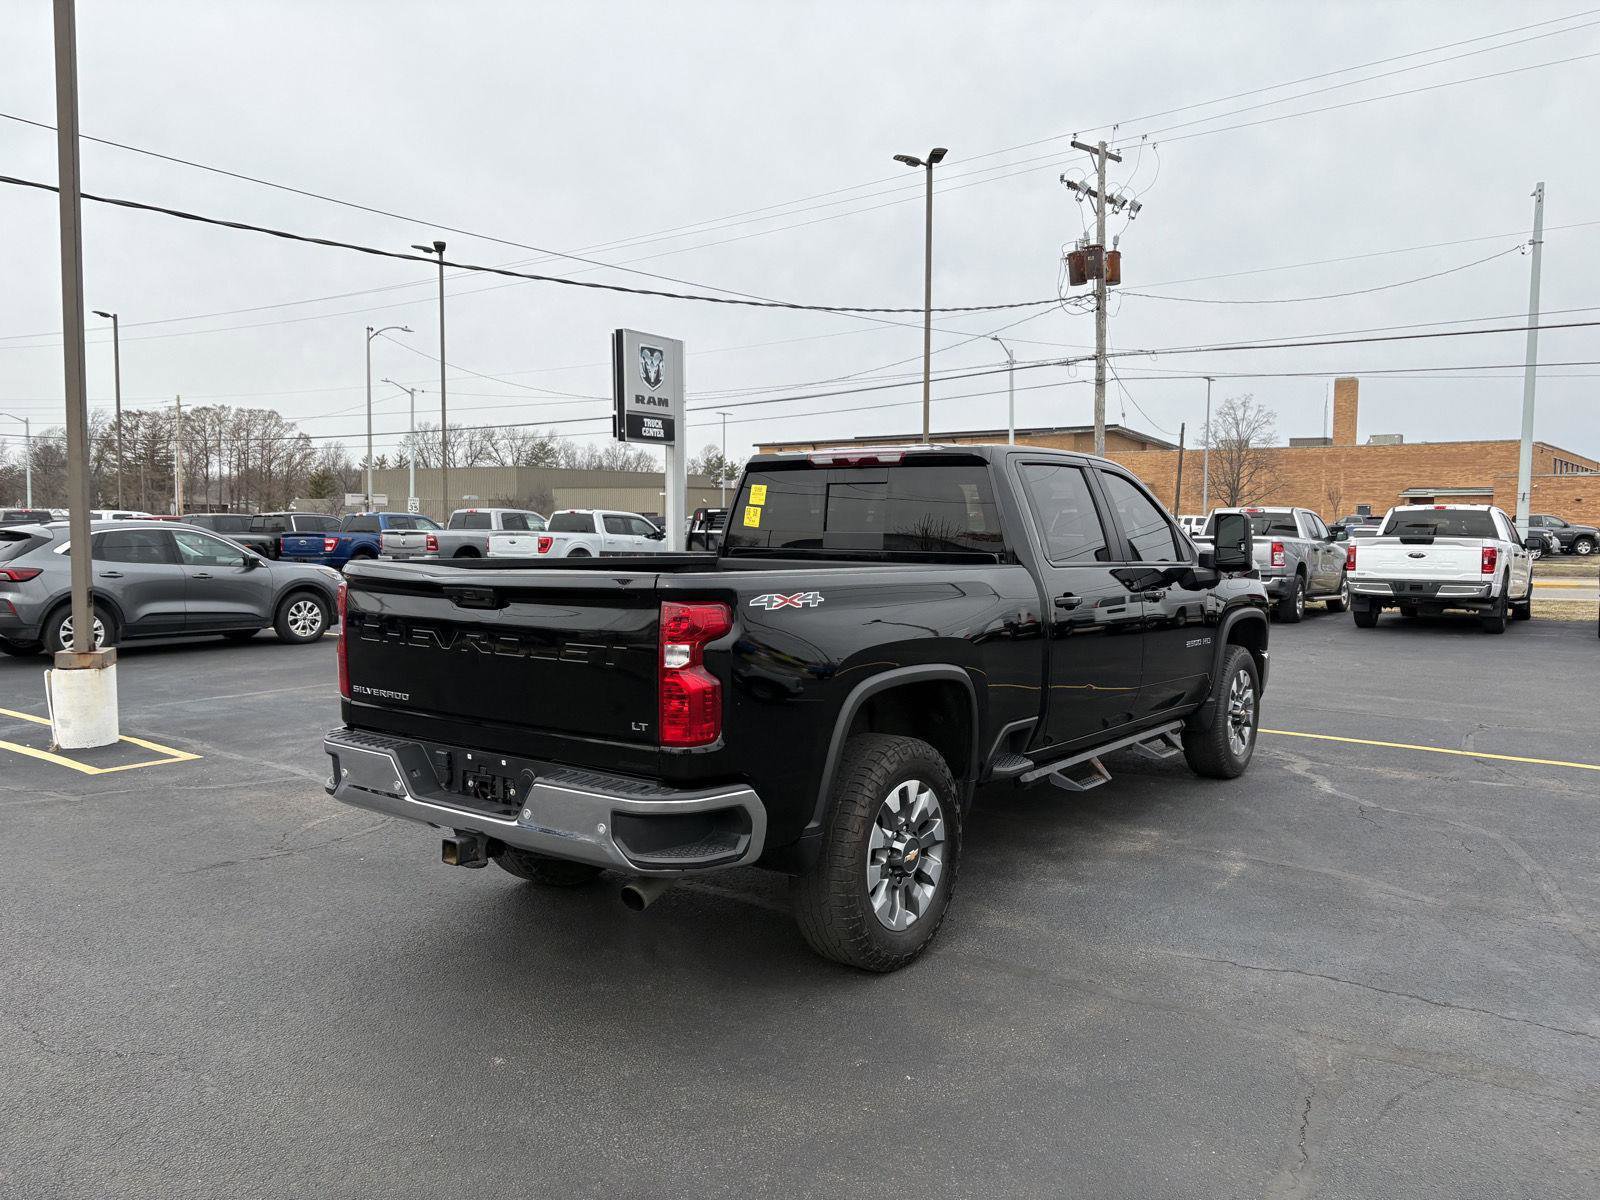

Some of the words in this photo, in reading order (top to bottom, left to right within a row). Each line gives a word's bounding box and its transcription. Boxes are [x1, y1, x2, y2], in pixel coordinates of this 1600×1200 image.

[635, 394, 669, 407] RAM
[644, 418, 662, 428] TRUCK
[642, 428, 664, 438] CENTER
[352, 684, 410, 701] SILVERADO
[631, 721, 649, 732] LT
